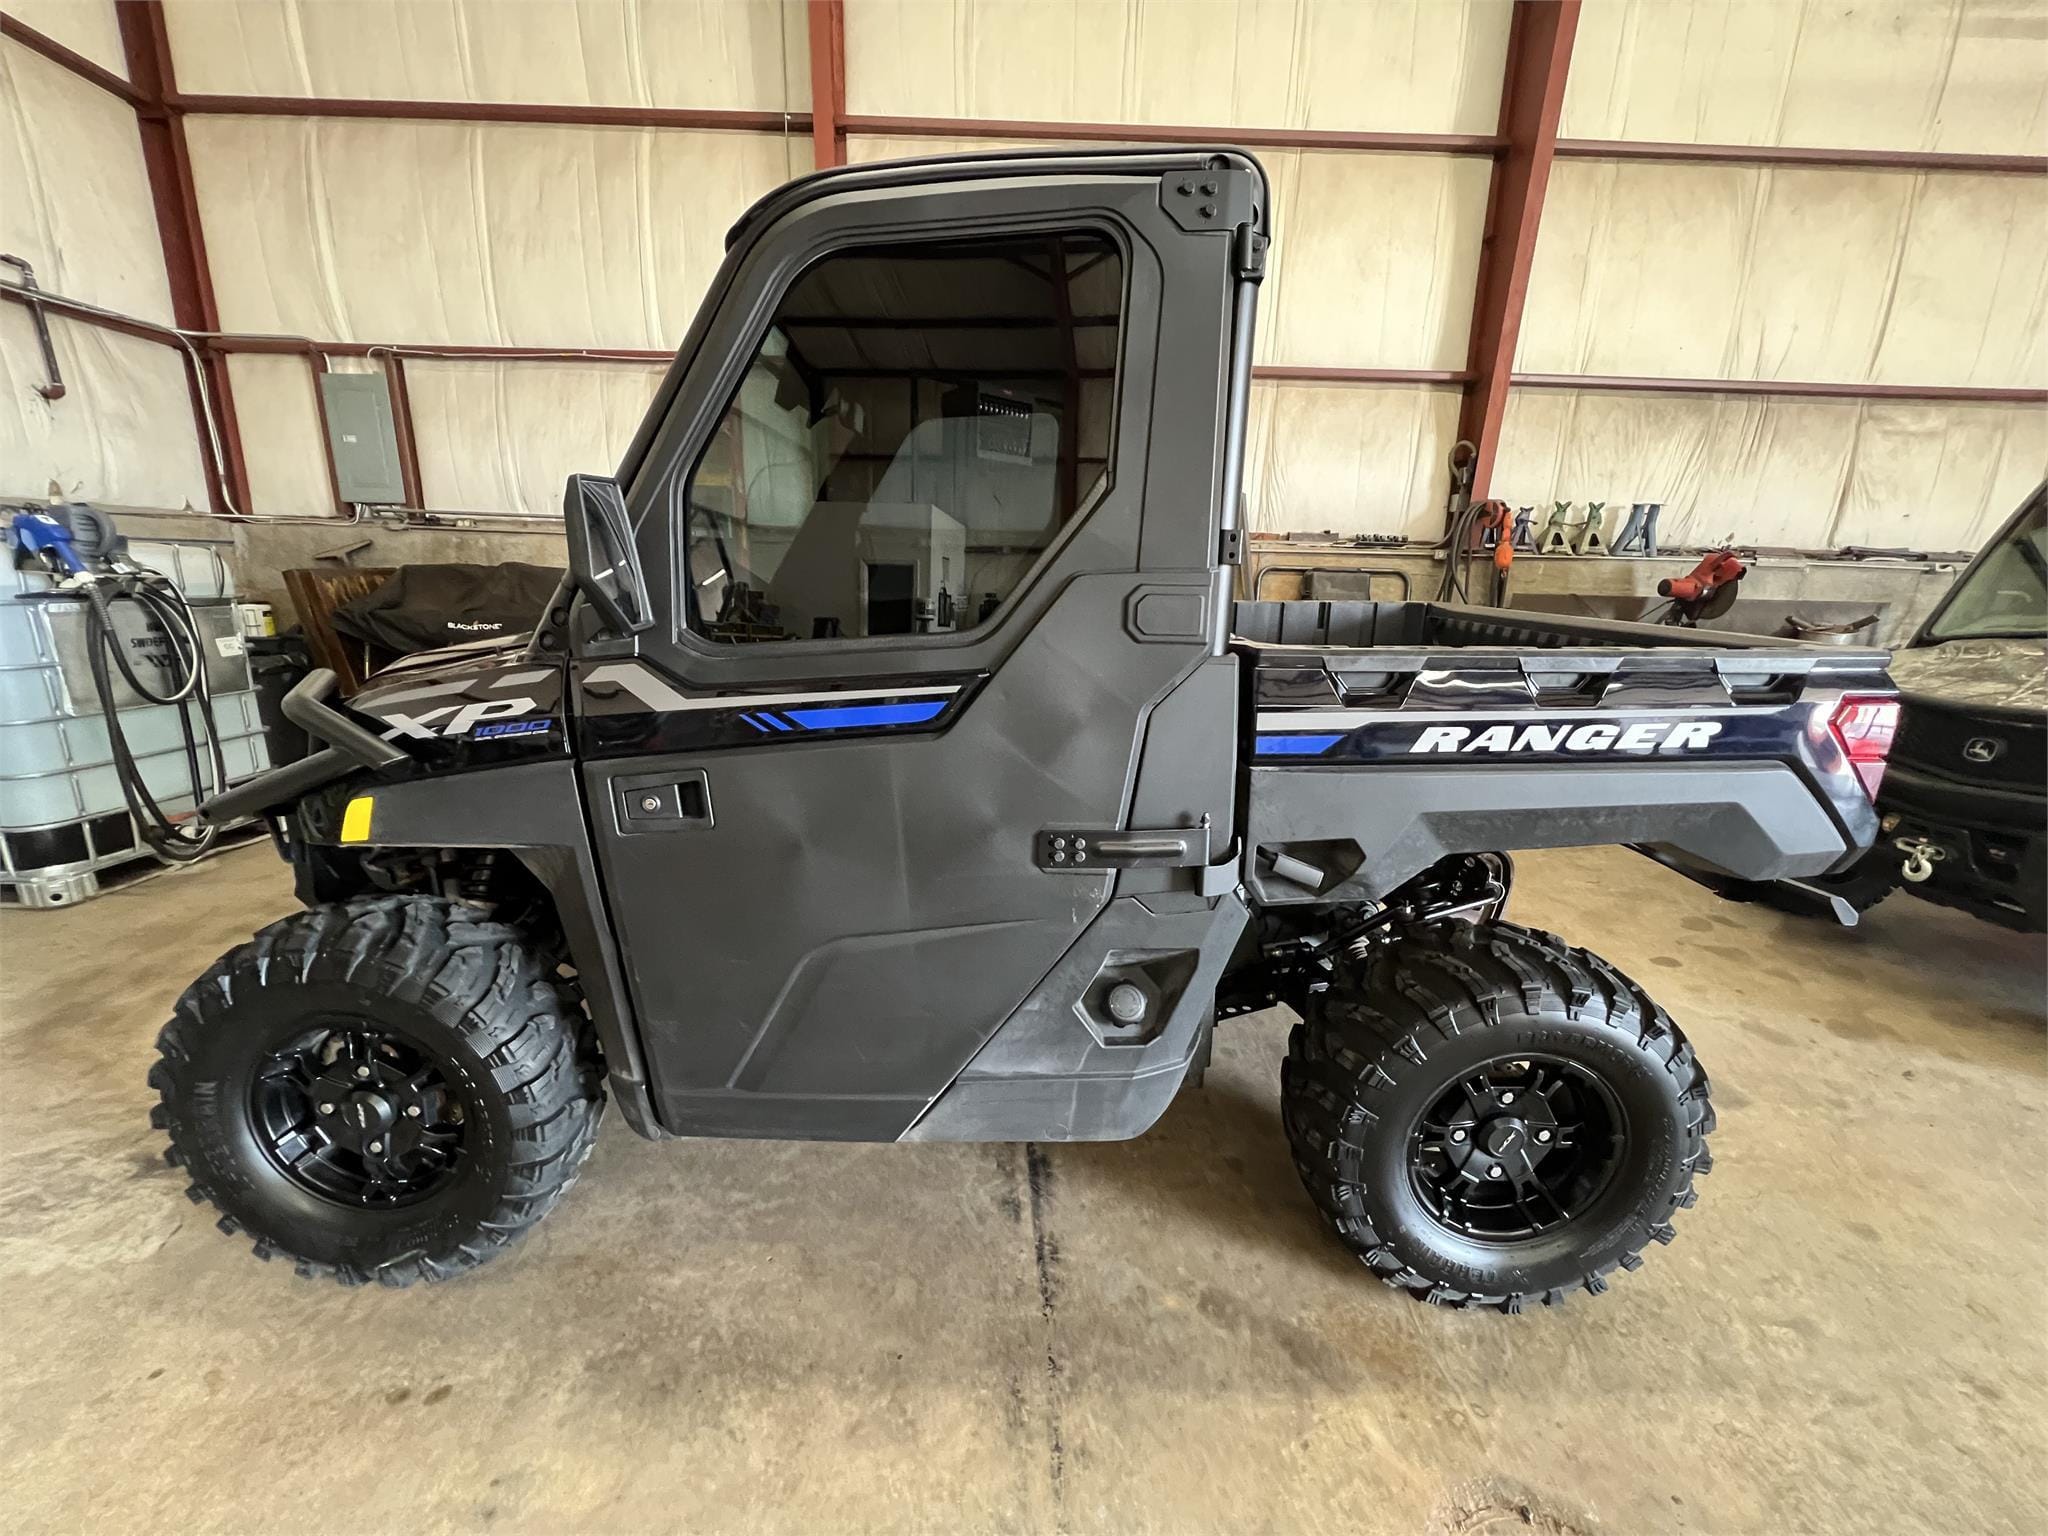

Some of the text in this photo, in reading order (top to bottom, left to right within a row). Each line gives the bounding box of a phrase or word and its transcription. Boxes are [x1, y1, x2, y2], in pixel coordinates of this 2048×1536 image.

[379, 697, 552, 741] XP 1000
[1409, 721, 1723, 753] RANGER
